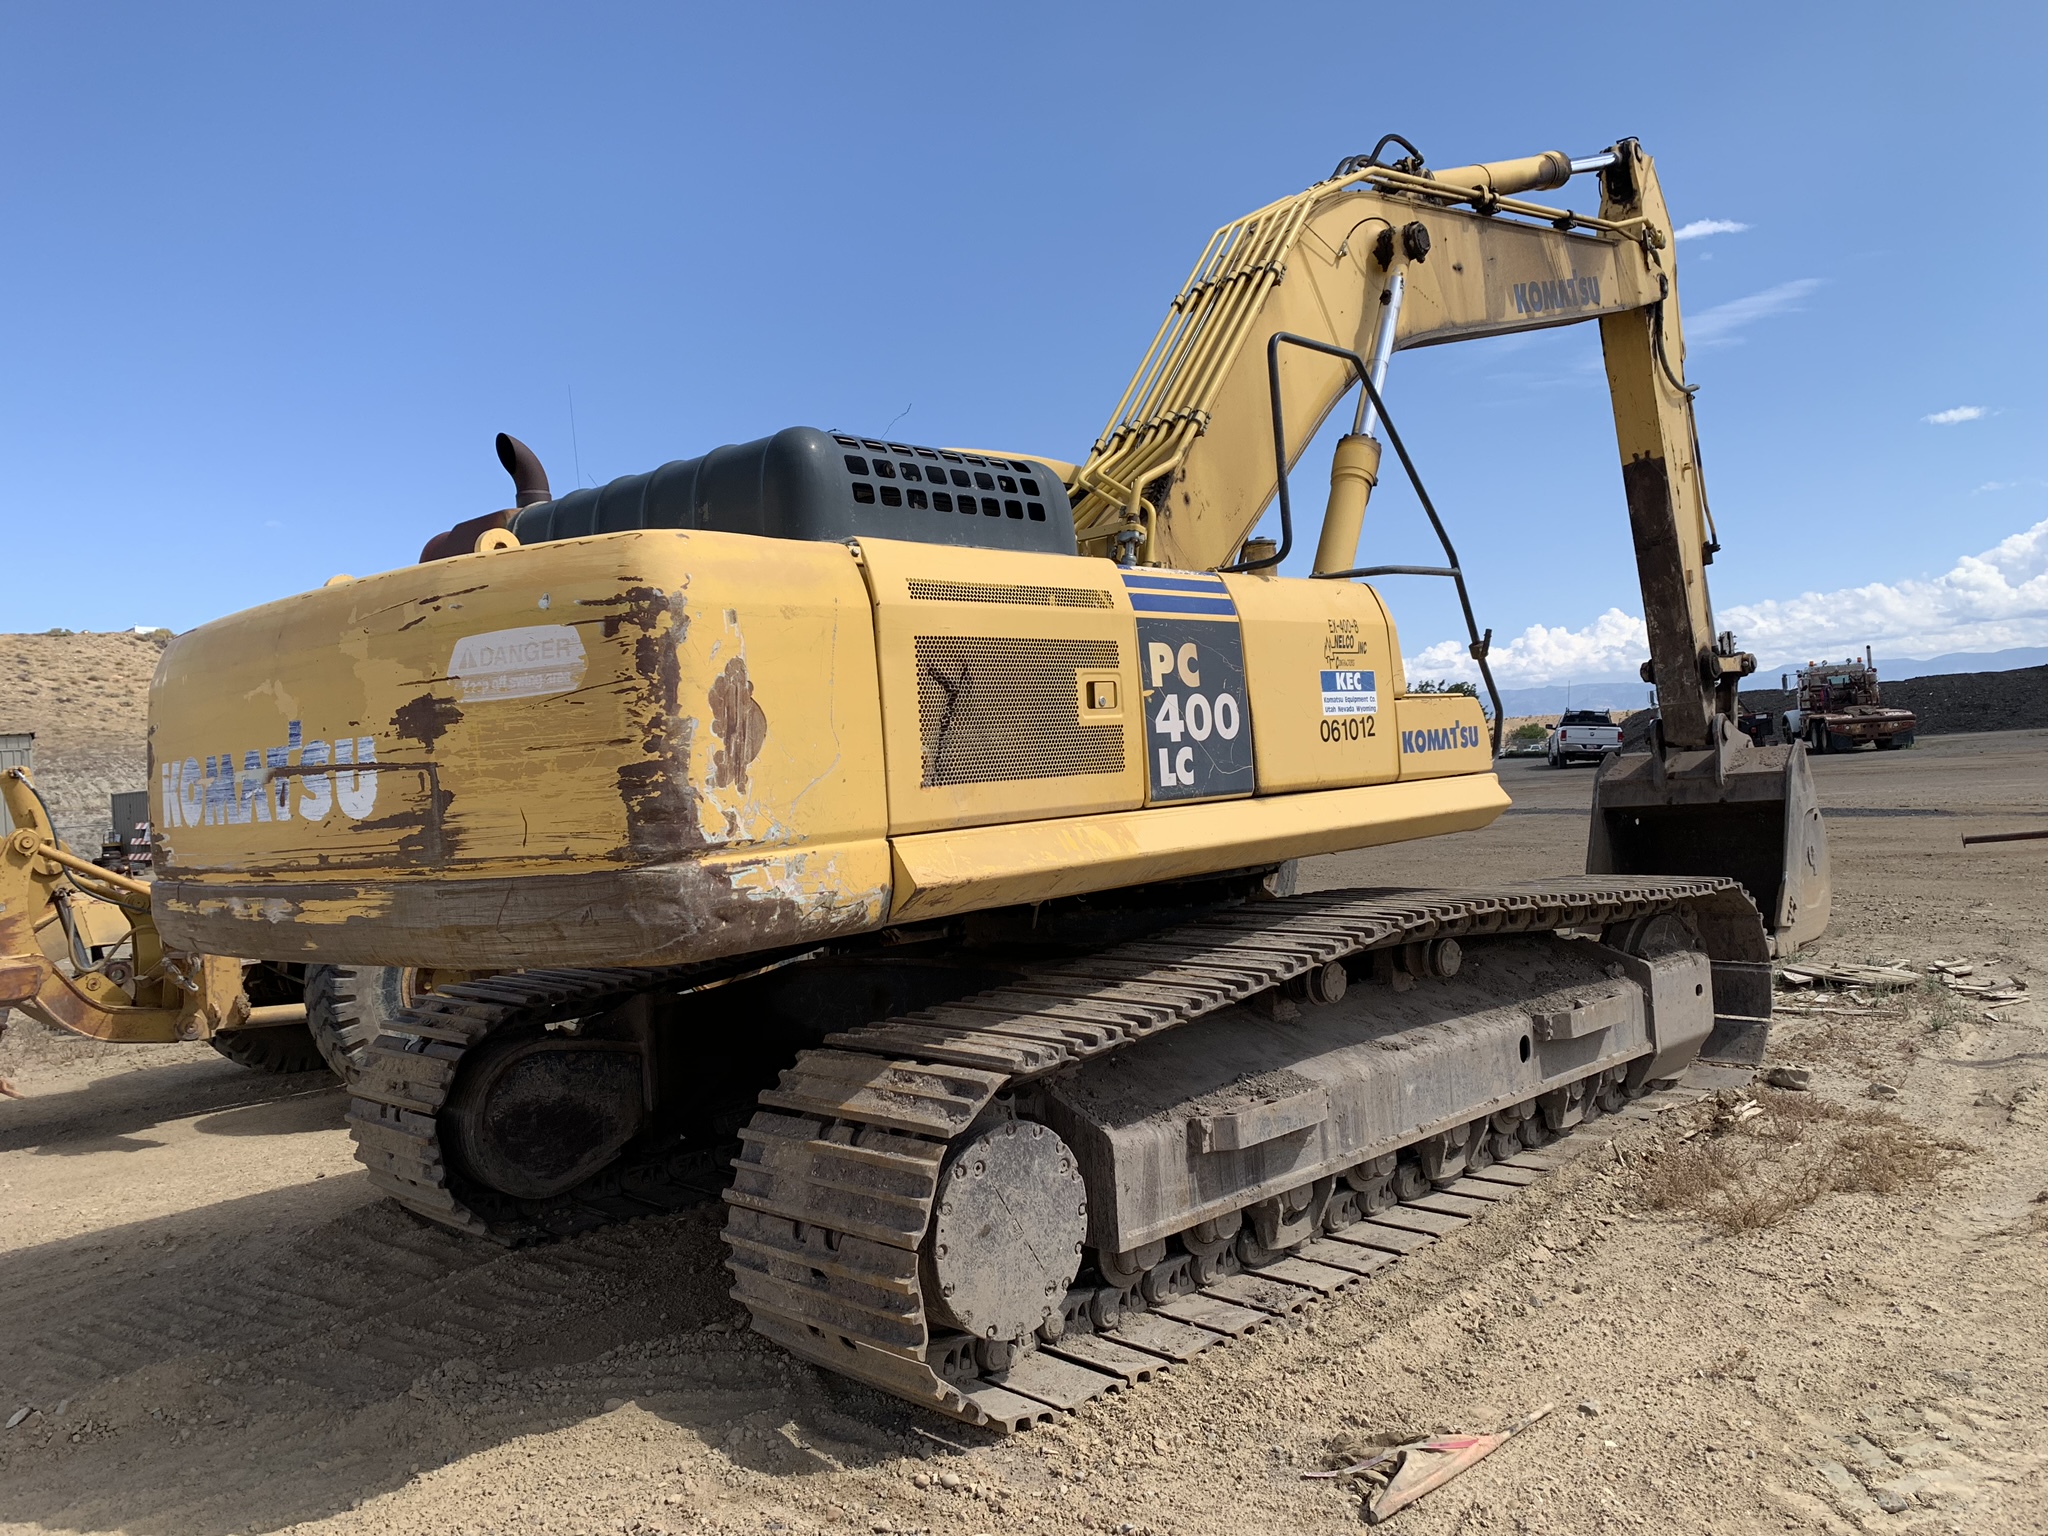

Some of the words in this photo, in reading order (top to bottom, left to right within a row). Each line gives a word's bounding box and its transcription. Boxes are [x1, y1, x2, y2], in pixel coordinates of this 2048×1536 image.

[1513, 269, 1600, 313] KOMATSU
[480, 638, 571, 666] DANGER
[1334, 635, 1354, 649] NELCO
[1148, 642, 1200, 687] PC
[1336, 672, 1362, 690] KEC
[1345, 696, 1369, 704] Equipment
[1356, 705, 1377, 713] Wyoming
[1155, 693, 1240, 742] 400
[1320, 715, 1376, 742] 061012
[1402, 720, 1479, 754] KOMATSU
[162, 720, 377, 828] KOMATSU
[1159, 746, 1195, 787] LC
